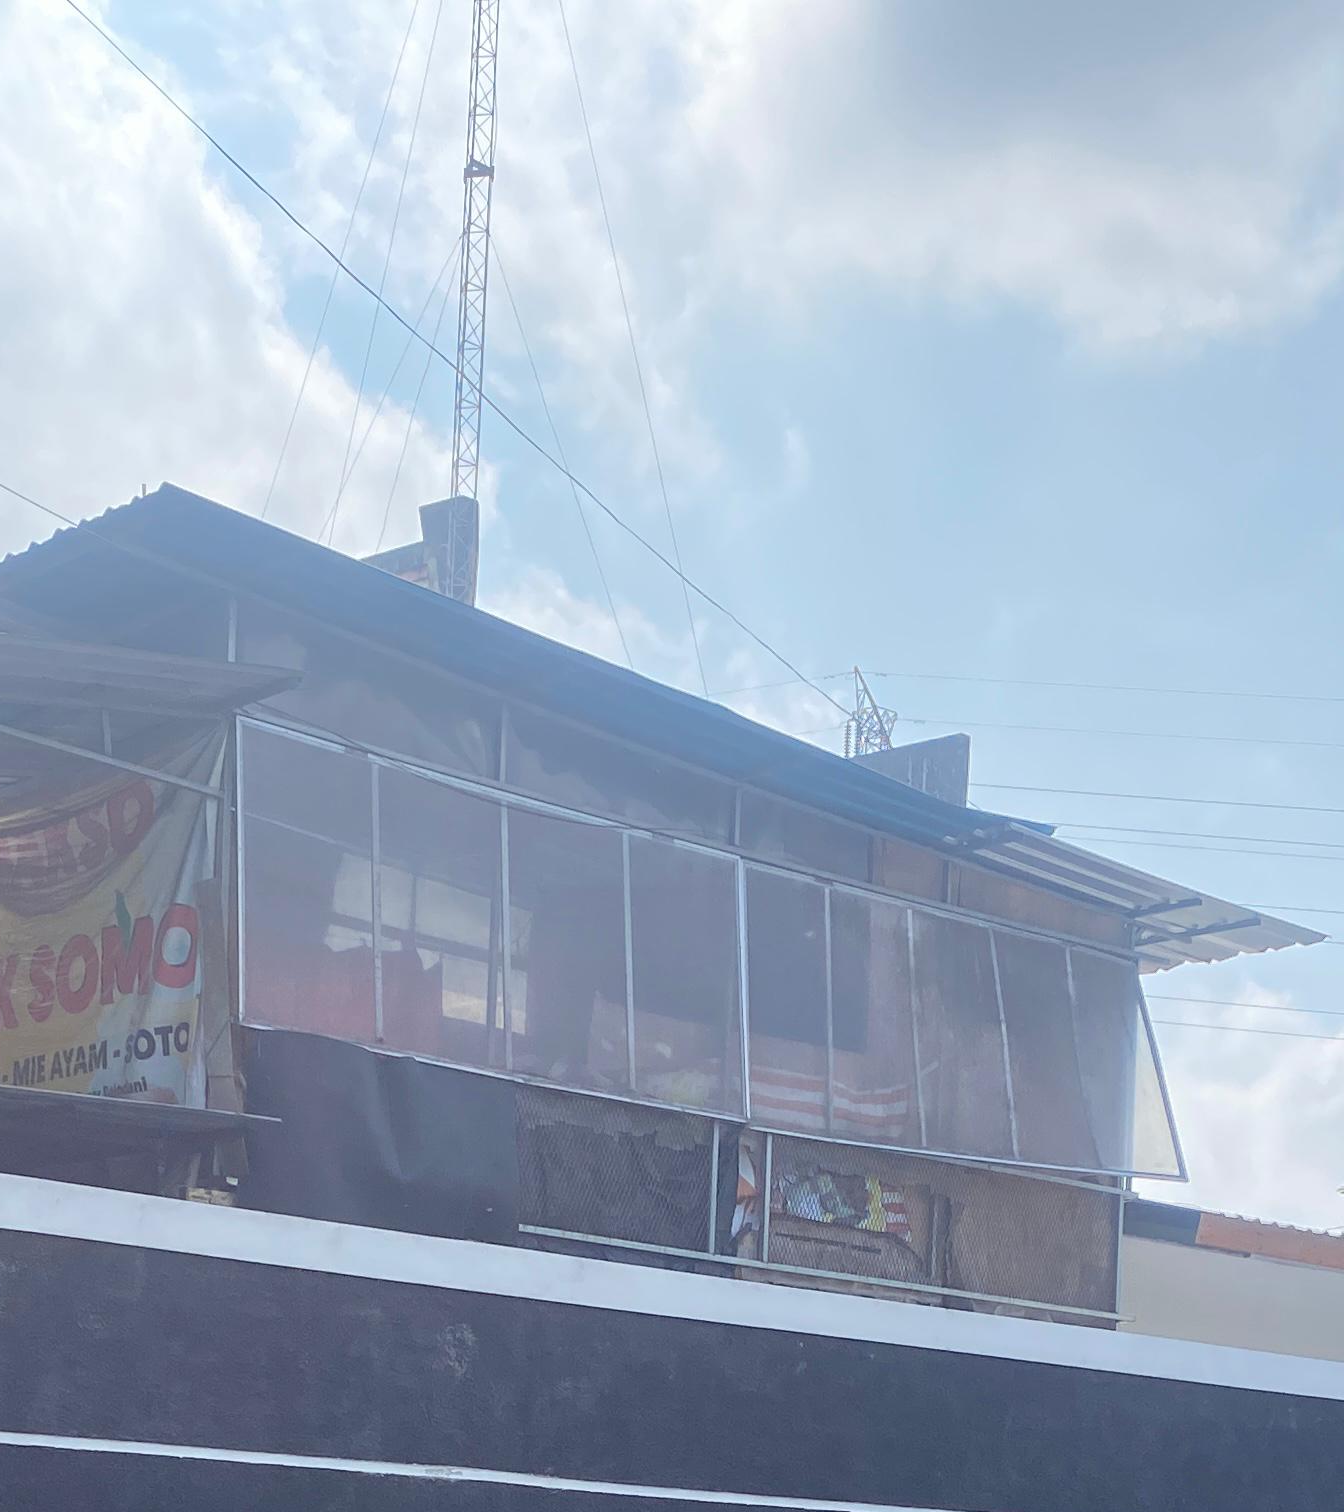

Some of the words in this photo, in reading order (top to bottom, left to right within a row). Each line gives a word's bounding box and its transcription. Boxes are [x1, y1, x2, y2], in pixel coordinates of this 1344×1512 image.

[27, 903, 198, 1022] SOMO
[13, 1054, 46, 1086] MIE
[50, 1040, 108, 1081] AYAM
[124, 1022, 191, 1064] SOTO
